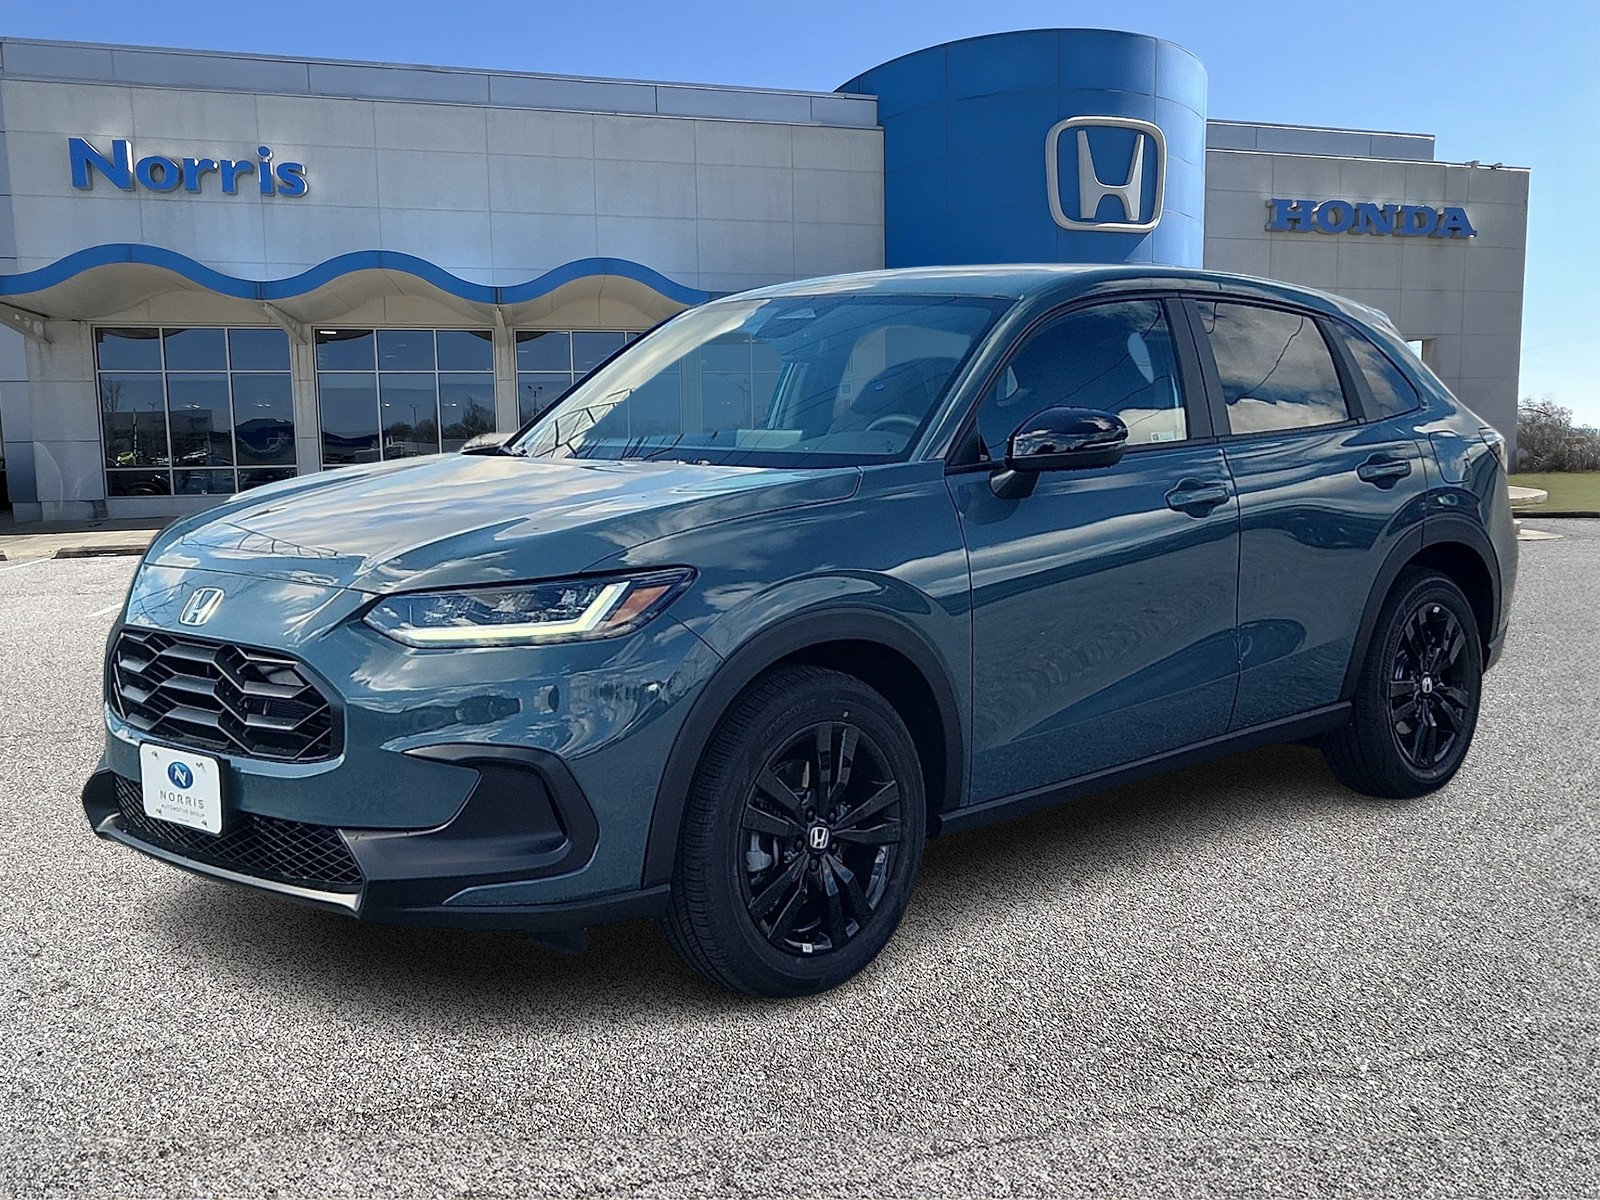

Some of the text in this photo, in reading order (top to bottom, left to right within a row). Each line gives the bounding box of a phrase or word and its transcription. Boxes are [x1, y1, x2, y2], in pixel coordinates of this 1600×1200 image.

[68, 137, 309, 198] Norris
[1265, 198, 1477, 239] HONDA
[160, 790, 205, 809] NORRIS
